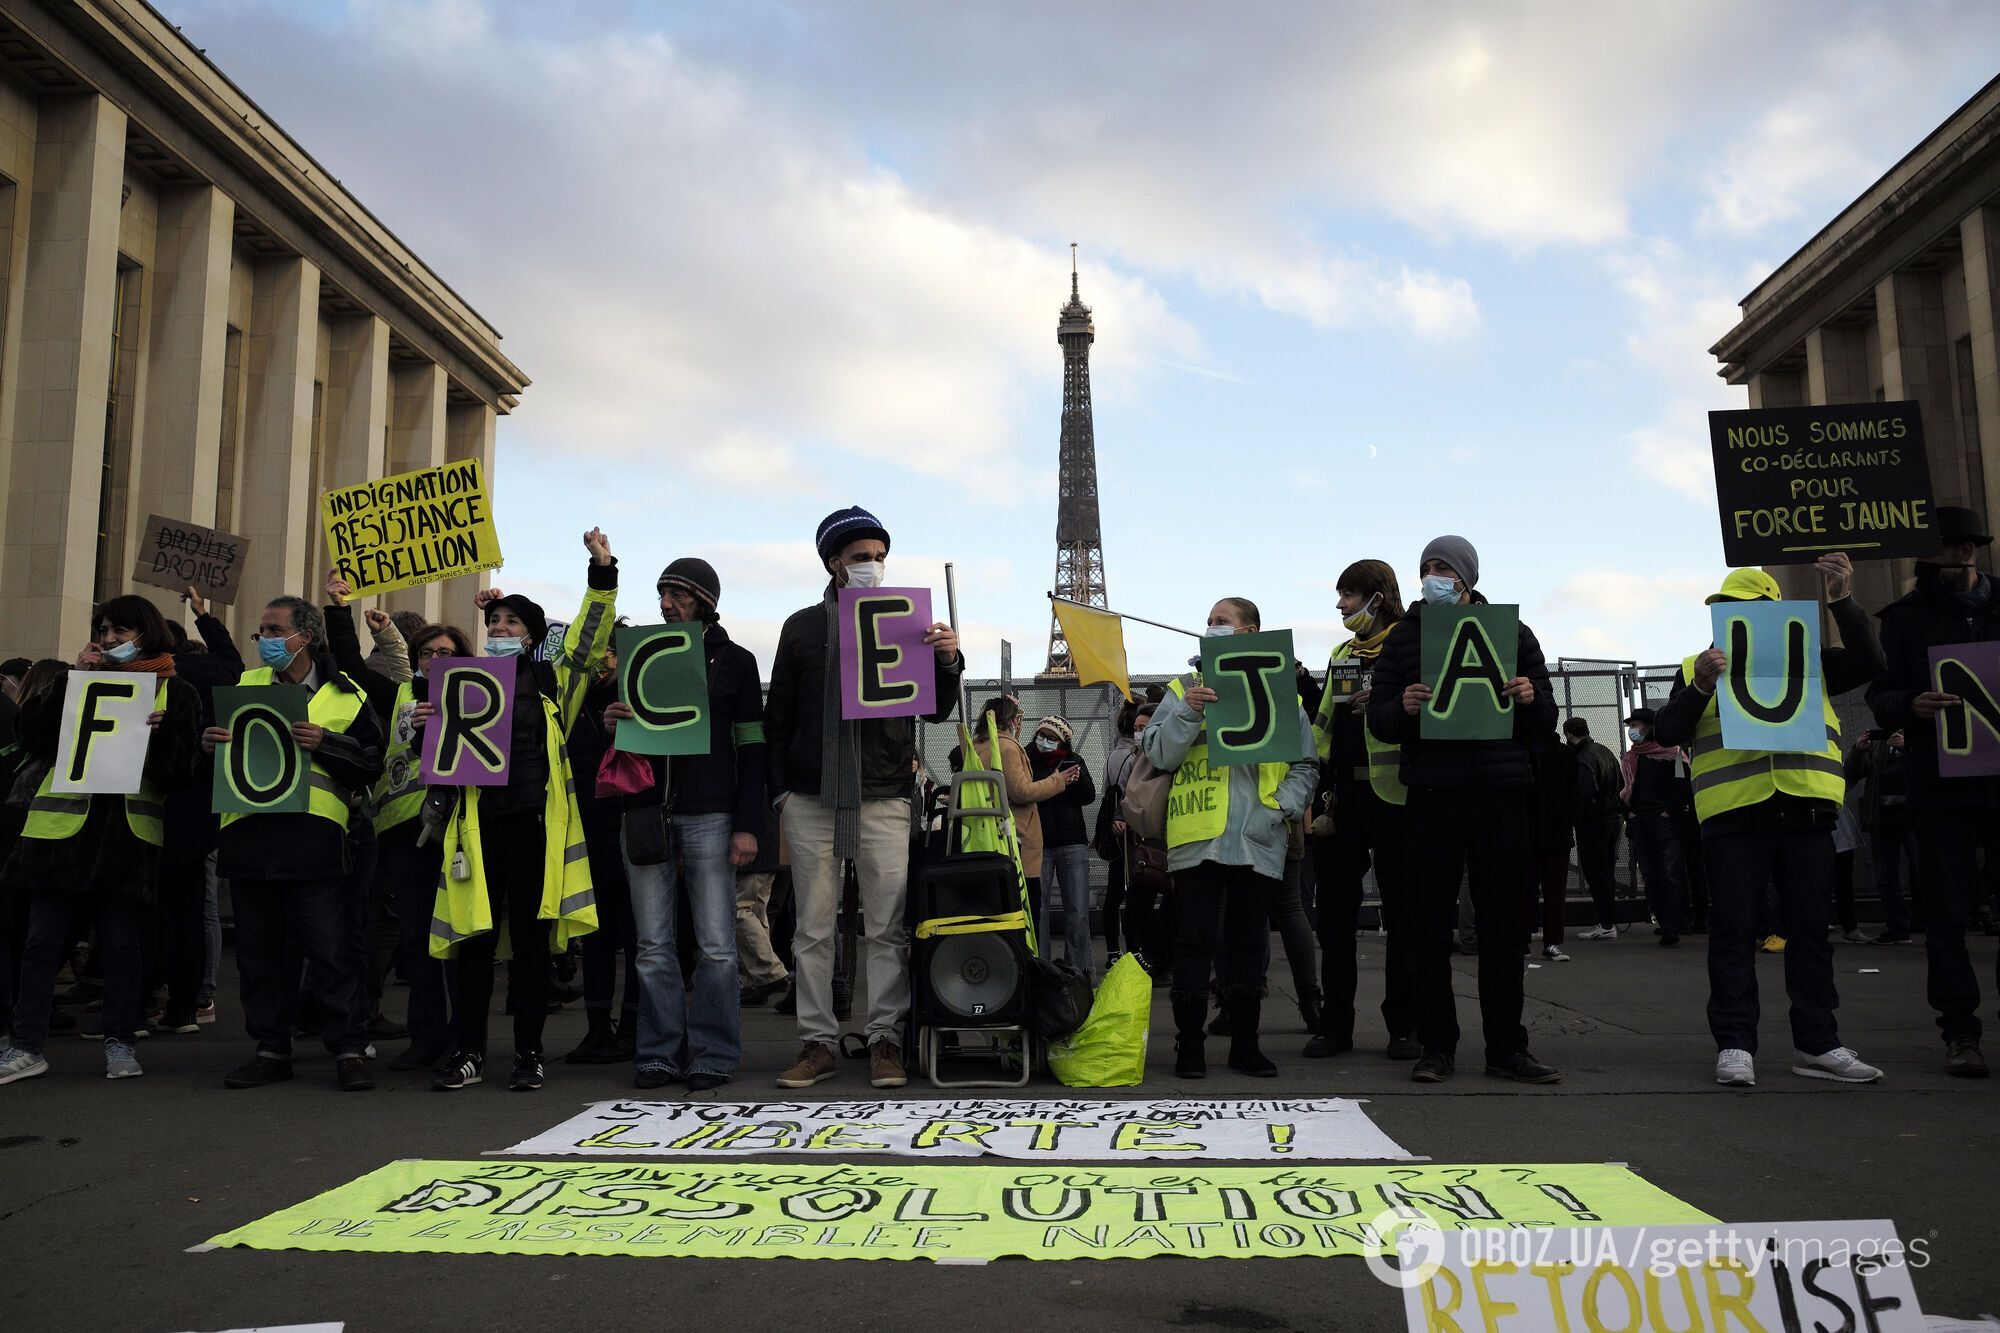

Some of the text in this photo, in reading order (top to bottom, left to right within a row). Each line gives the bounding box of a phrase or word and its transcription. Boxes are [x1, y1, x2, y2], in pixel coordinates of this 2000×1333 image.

[1727, 418, 1907, 449] NOUS SOMMES
[1740, 447, 1902, 473] CO-DÉCLARANTS
[1790, 477, 1859, 499] POUR
[1734, 499, 1930, 539] FORCE JAUNE
[544, 629, 563, 660] ASTEX
[855, 595, 919, 707] E
[623, 630, 701, 730] C
[1428, 616, 1515, 720] A
[1724, 614, 1811, 728] U
[1214, 651, 1286, 751] J
[65, 680, 141, 784] F
[432, 667, 506, 777] R
[223, 703, 302, 808] O
[1174, 758, 1221, 786] ORCE
[1169, 786, 1218, 820] AUNE
[594, 1102, 810, 1121] STOP
[1096, 1110, 1269, 1121] GLOBALE
[1265, 1123, 1296, 1153] !
[288, 1217, 400, 1238] DE
